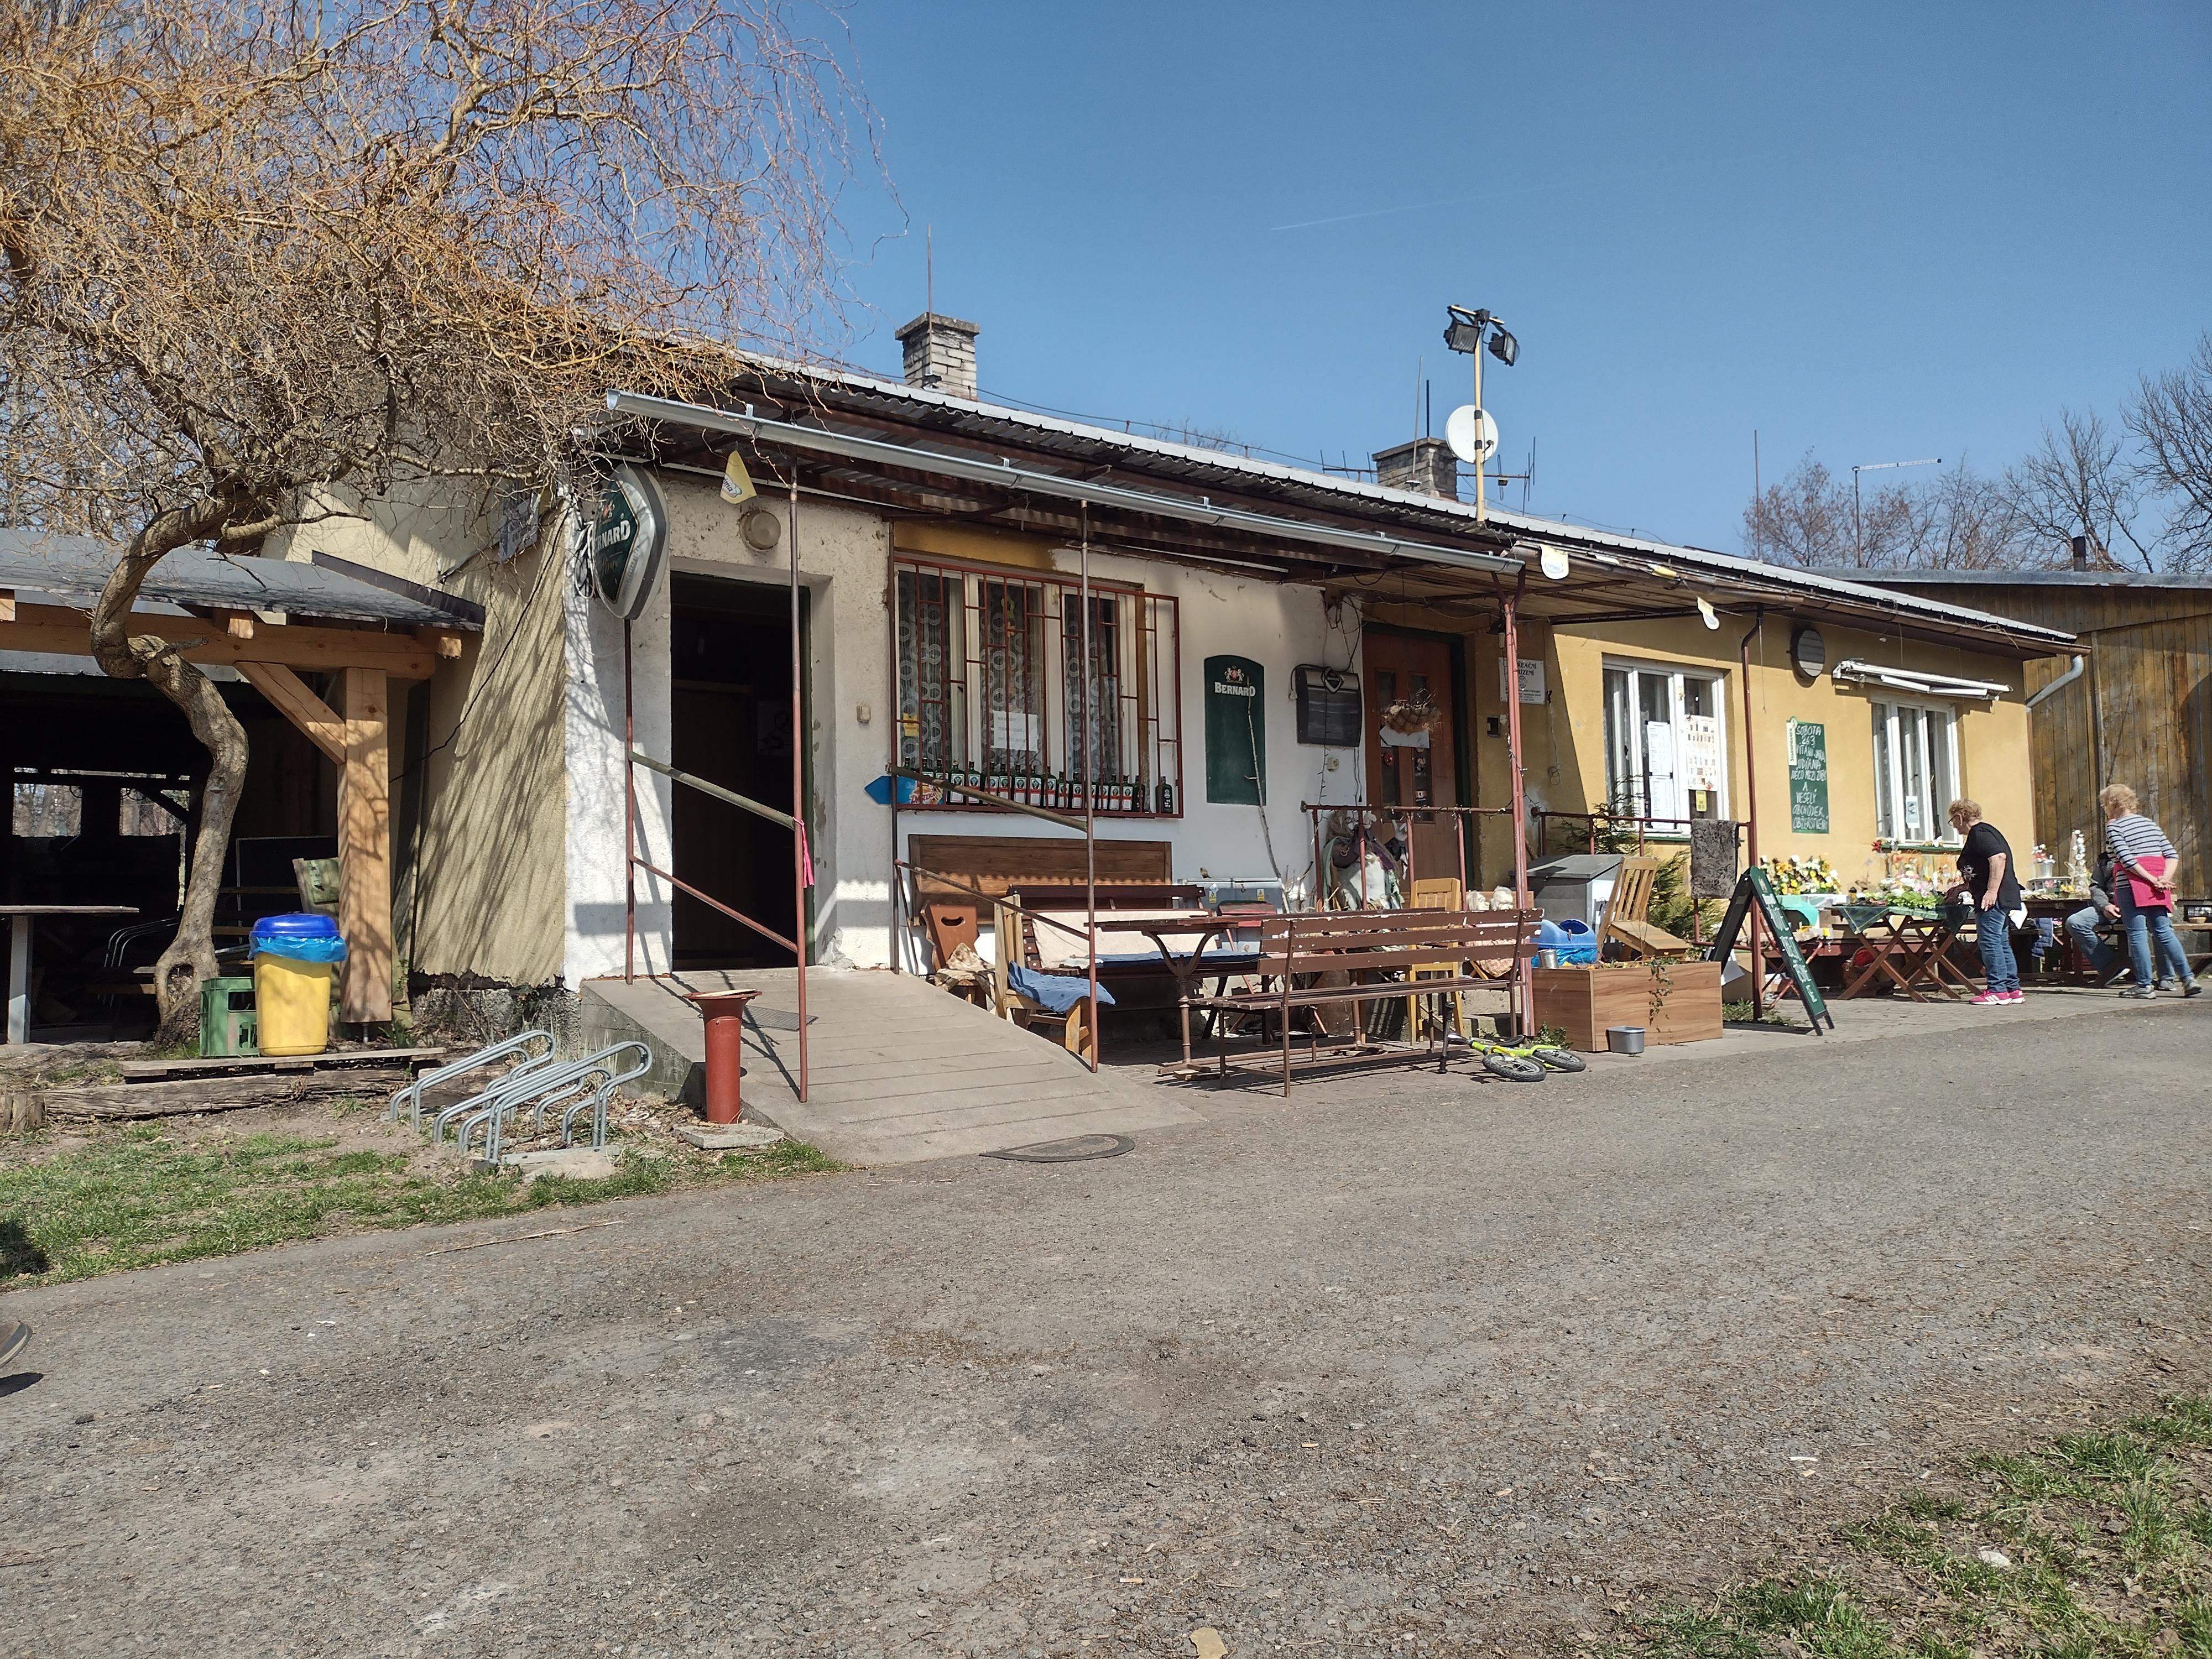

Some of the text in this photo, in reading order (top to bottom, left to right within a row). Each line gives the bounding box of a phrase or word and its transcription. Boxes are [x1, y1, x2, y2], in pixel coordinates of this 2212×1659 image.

[723, 478, 733, 493] ima
[1214, 682, 1256, 697] BERNARD
[1796, 725, 1821, 735] SOBOTA
[1802, 781, 1808, 791] A
